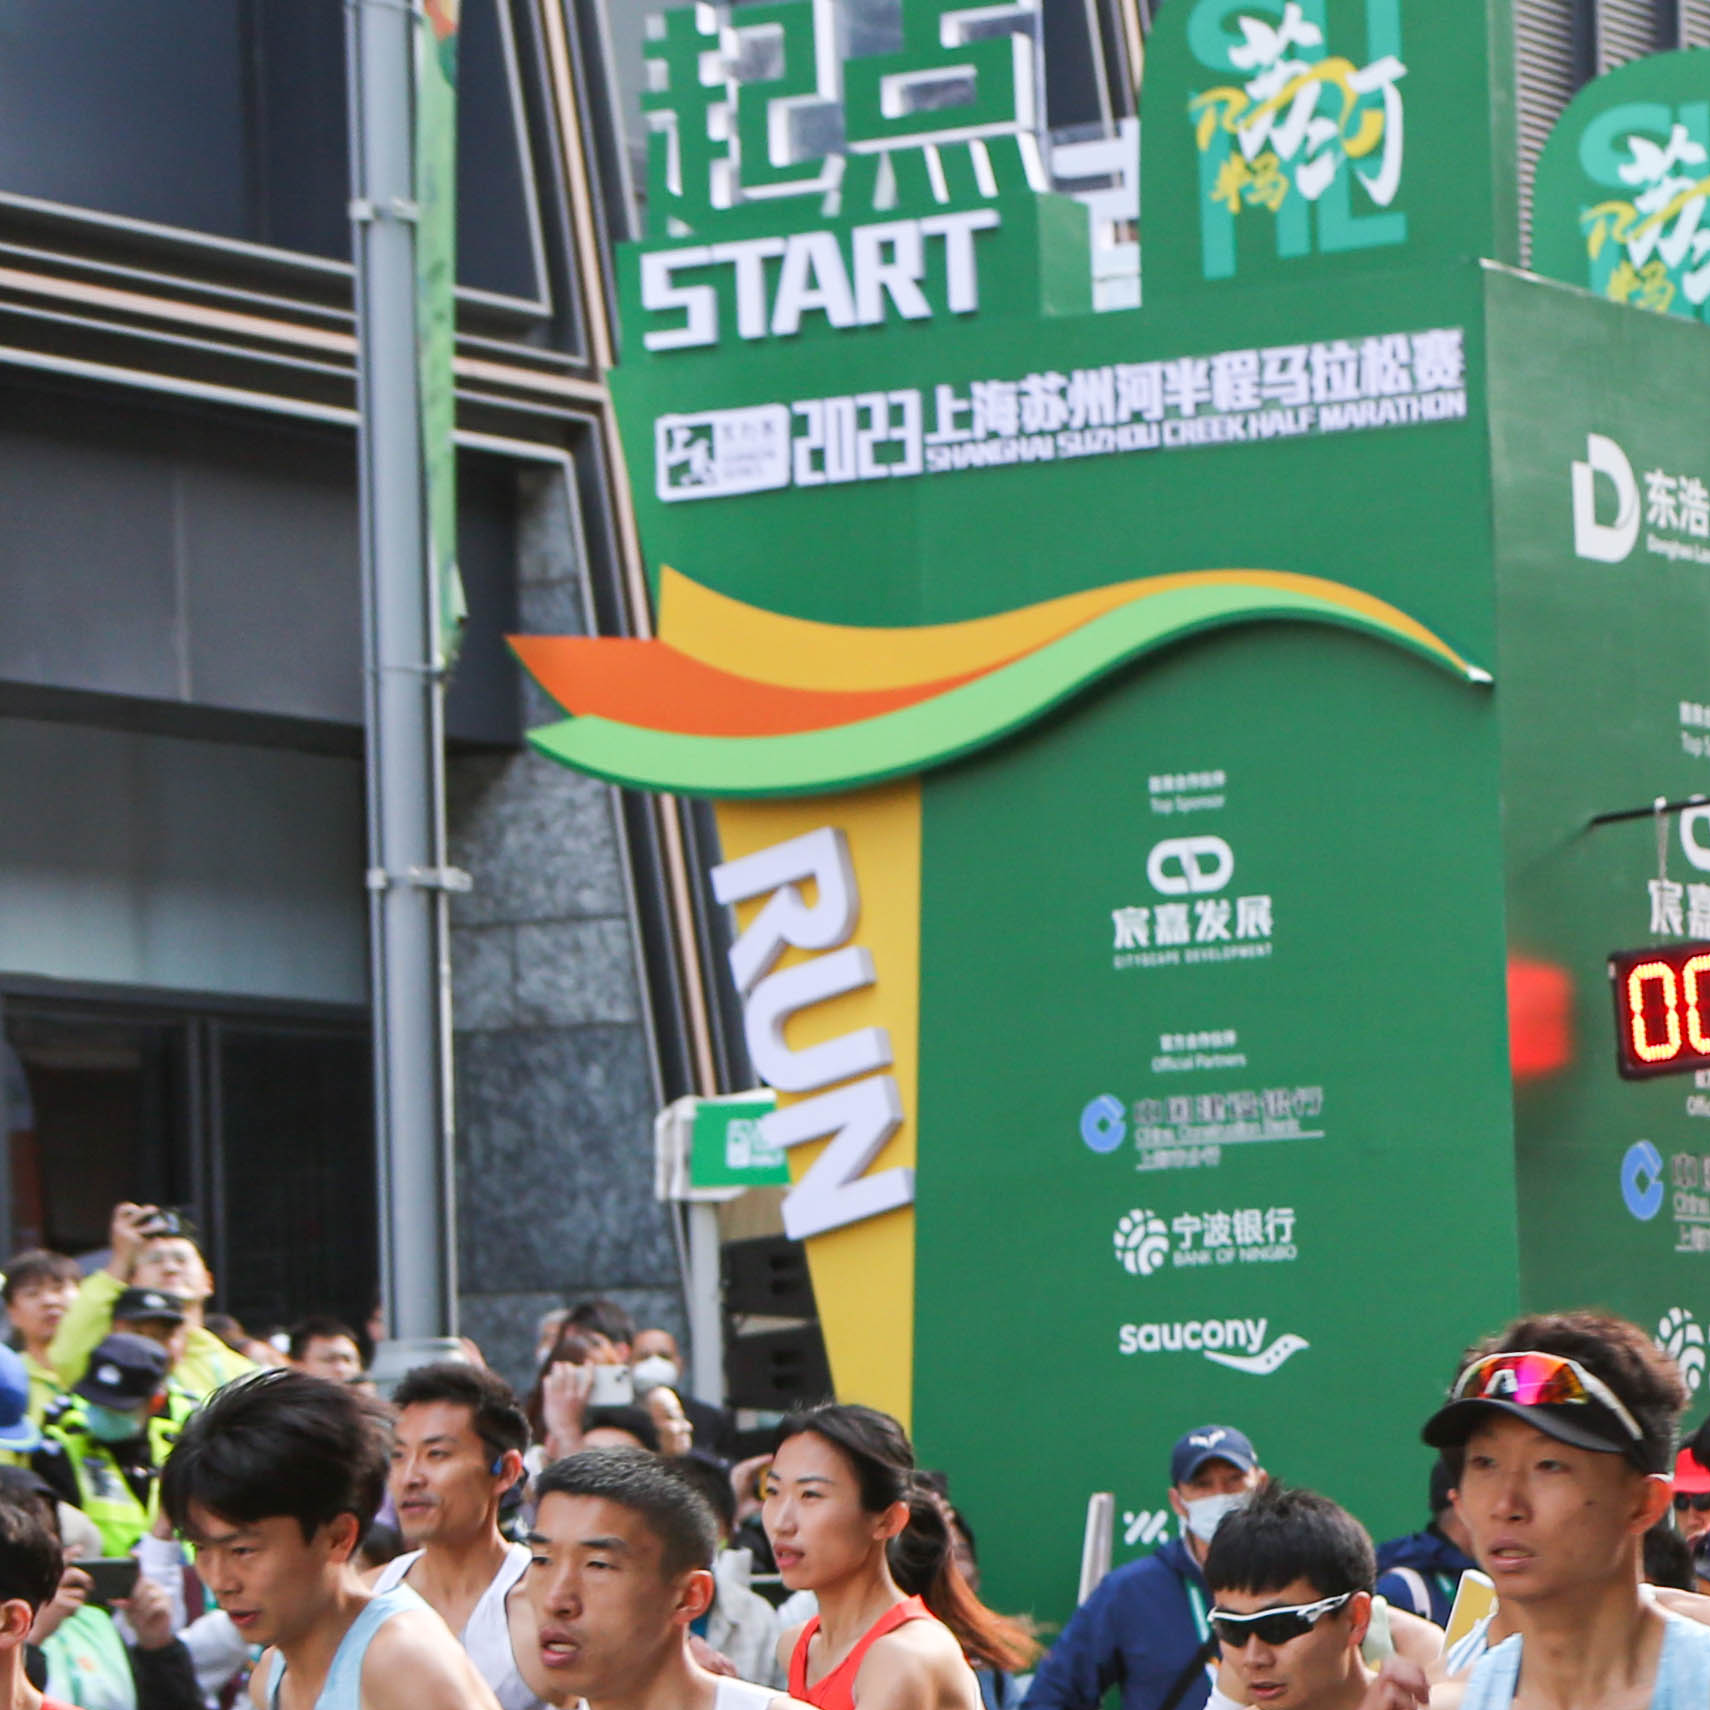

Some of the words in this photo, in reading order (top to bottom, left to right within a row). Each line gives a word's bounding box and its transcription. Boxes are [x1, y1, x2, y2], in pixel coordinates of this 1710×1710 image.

[641, 209, 998, 351] START
[791, 388, 923, 487] 2023
[923, 326, 1466, 447] 上海苏州河半程马拉松赛
[926, 431, 1056, 472] SHANGHAI
[1057, 421, 1159, 459] SUZHOU
[1162, 413, 1247, 448] CREEK
[1250, 406, 1316, 438] HALF
[1318, 390, 1468, 432] MARATHON
[1111, 894, 1274, 949] 宸嘉发展
[711, 826, 914, 1241] RUN
[1152, 1055, 1194, 1073] Official
[1195, 1053, 1247, 1069] Partners
[1133, 1086, 1323, 1124] 中国建设银行
[1171, 1206, 1296, 1250] 宁波银行
[1172, 1250, 1212, 1268] BANK
[1215, 1247, 1236, 1265] OF
[1239, 1244, 1299, 1264] NINGBO
[1119, 1318, 1268, 1356] saucony
